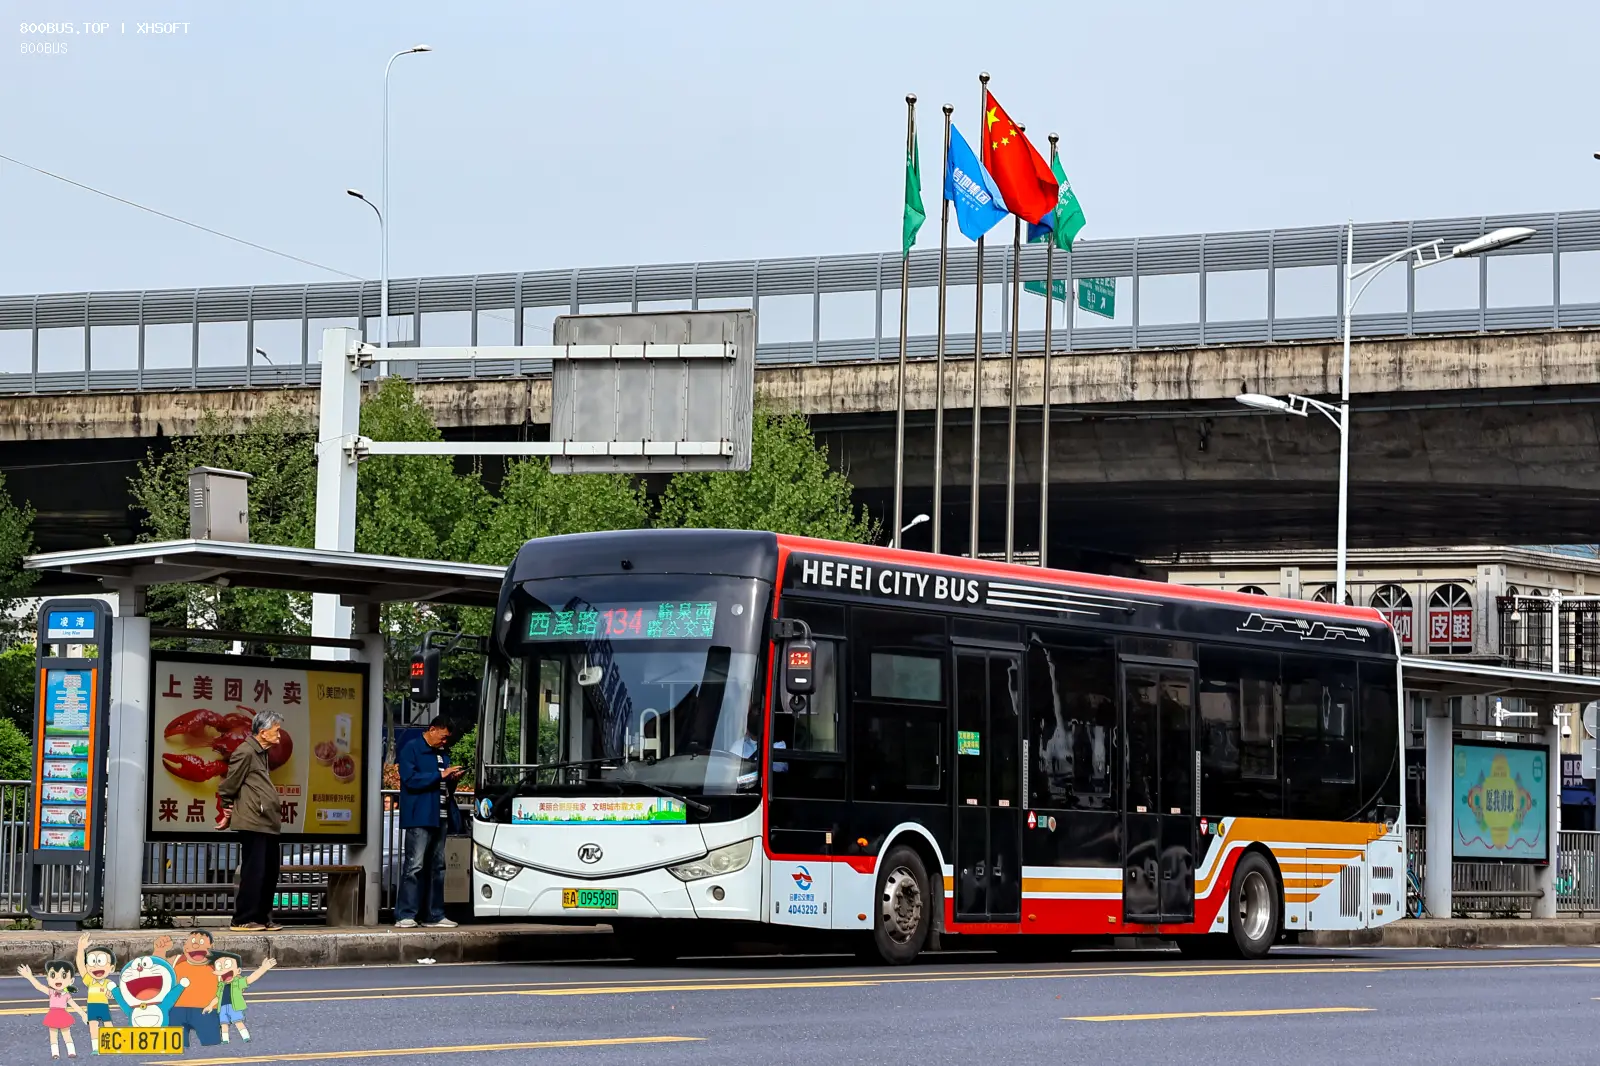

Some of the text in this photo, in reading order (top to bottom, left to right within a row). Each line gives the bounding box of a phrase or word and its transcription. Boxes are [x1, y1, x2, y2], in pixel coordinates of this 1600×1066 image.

[802, 559, 979, 604] HEFEI CITY BUS
[60, 616, 85, 628] 凌湾
[528, 607, 643, 637] 西溪路 134
[162, 674, 302, 705] 上美团外卖
[325, 686, 356, 700] 美团外卖
[788, 904, 818, 915] 4D43292
